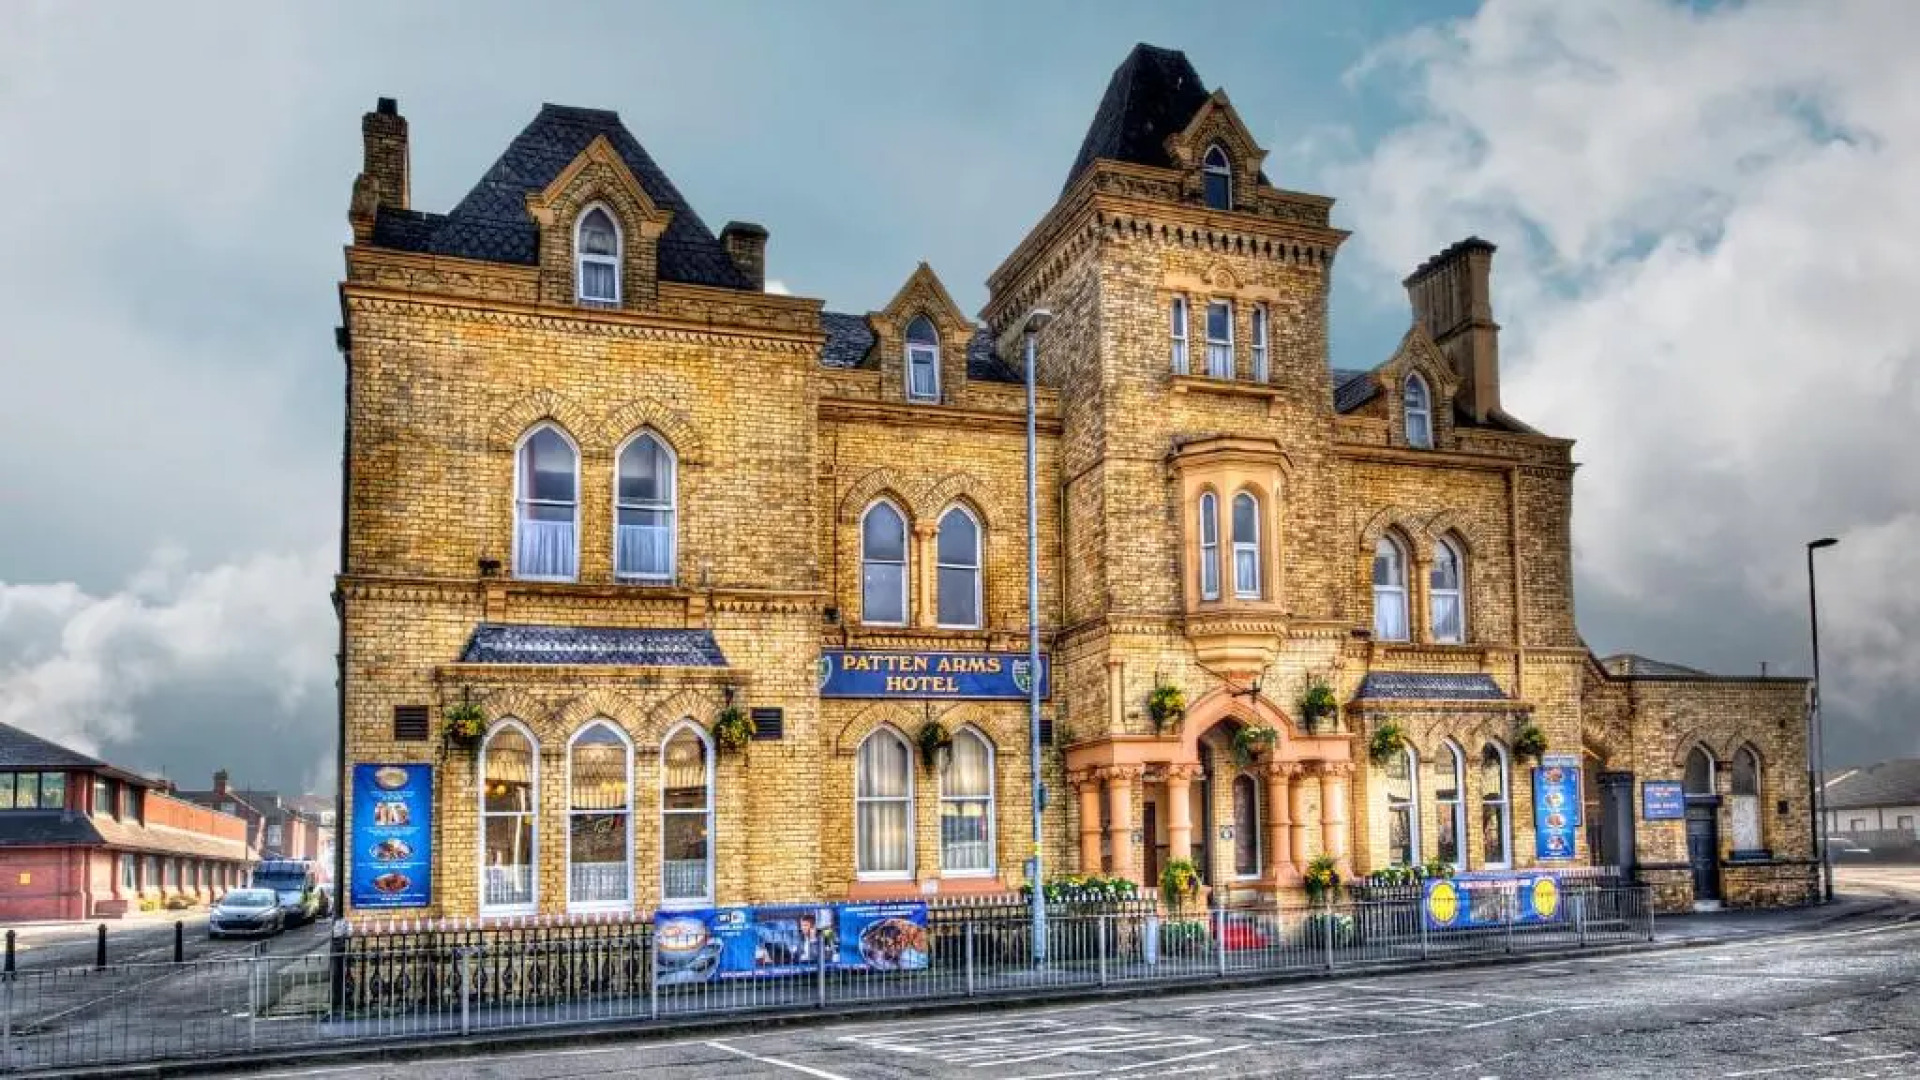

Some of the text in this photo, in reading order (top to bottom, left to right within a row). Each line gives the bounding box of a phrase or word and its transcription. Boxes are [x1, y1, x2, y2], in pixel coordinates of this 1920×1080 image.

[842, 655, 930, 671] PATTEN
[936, 657, 1002, 673] ARMS
[886, 676, 960, 693] HOTEL
